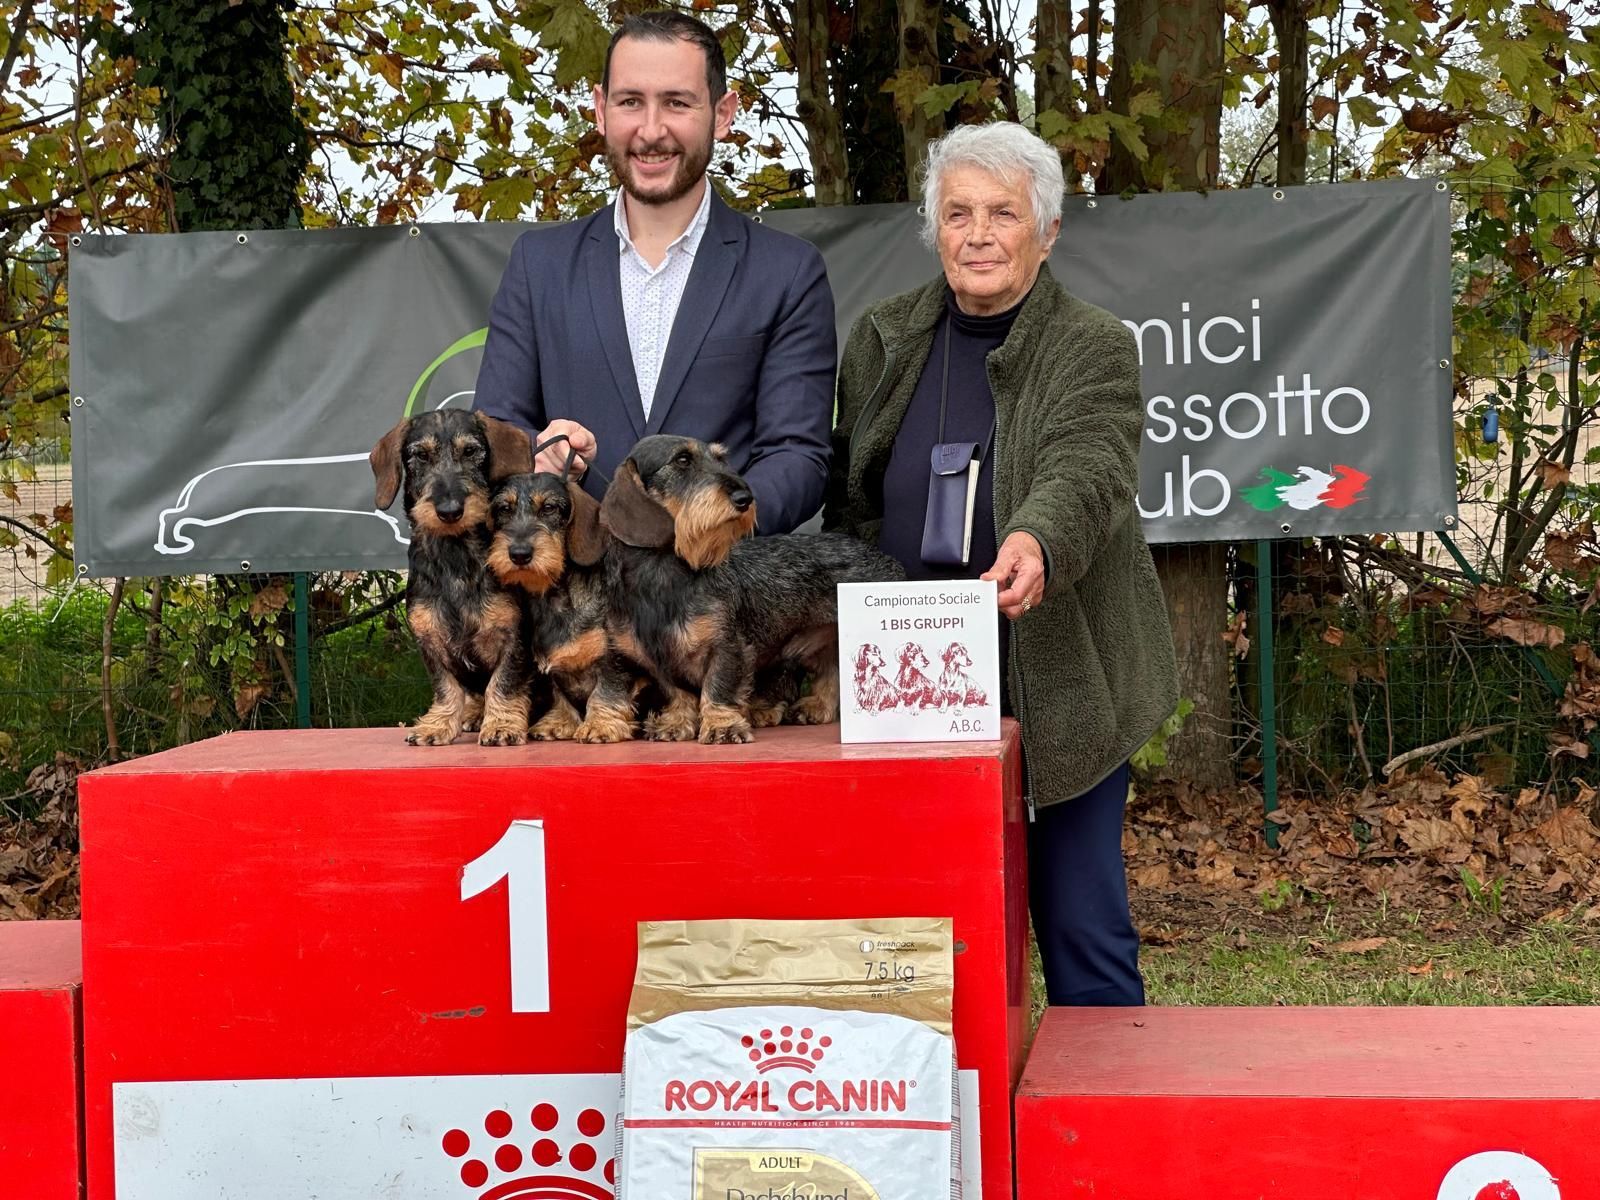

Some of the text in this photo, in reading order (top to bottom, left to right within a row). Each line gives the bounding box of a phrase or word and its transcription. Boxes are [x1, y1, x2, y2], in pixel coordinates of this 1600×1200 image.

[1122, 299, 1261, 366] mici
[1146, 373, 1371, 444] ssotto
[1135, 454, 1232, 520] ub
[864, 592, 981, 609] Campionato Sociale
[880, 617, 964, 631] 1 BIS GRUPPI
[949, 719, 984, 734] A.B.C.
[461, 819, 550, 1014] 1
[864, 961, 915, 983] 7.5 kg
[664, 1079, 779, 1112] ROYAL
[758, 1156, 803, 1169] ADULT
